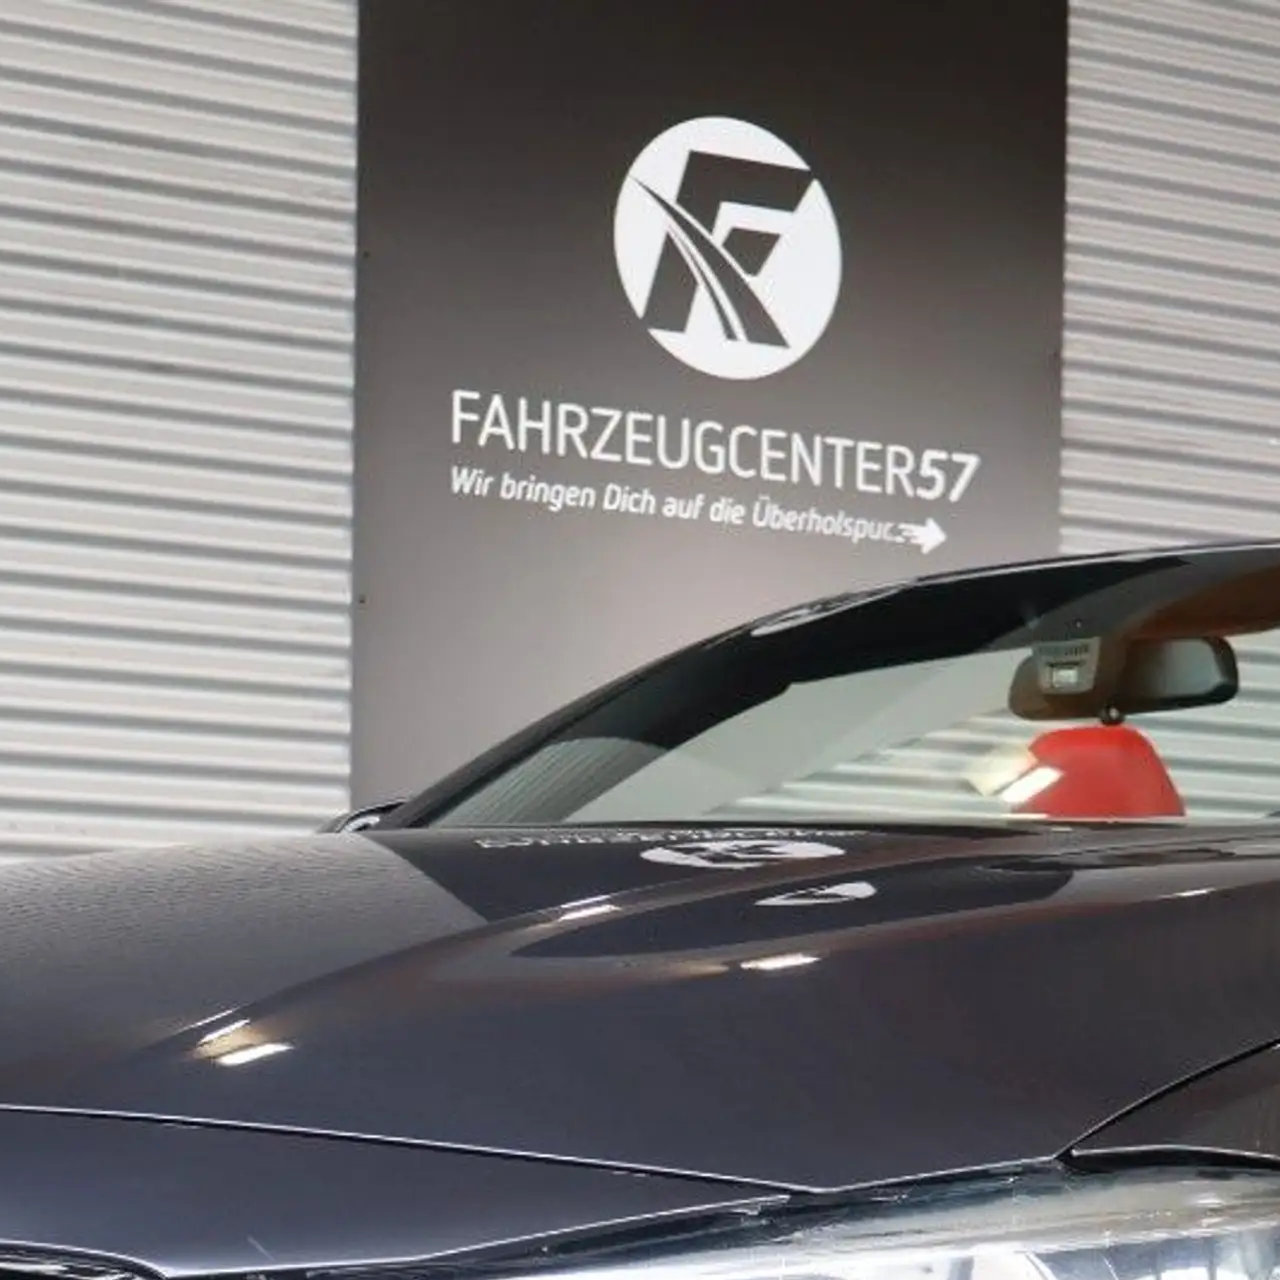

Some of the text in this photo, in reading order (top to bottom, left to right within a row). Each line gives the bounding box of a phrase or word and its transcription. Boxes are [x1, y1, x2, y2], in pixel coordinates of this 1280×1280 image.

[451, 389, 981, 503] FAHRZEUGCENTER57
[451, 466, 494, 497] Wir
[500, 473, 595, 512] bringen
[603, 483, 656, 515] Dich
[662, 493, 705, 520] auf
[709, 494, 746, 524] die
